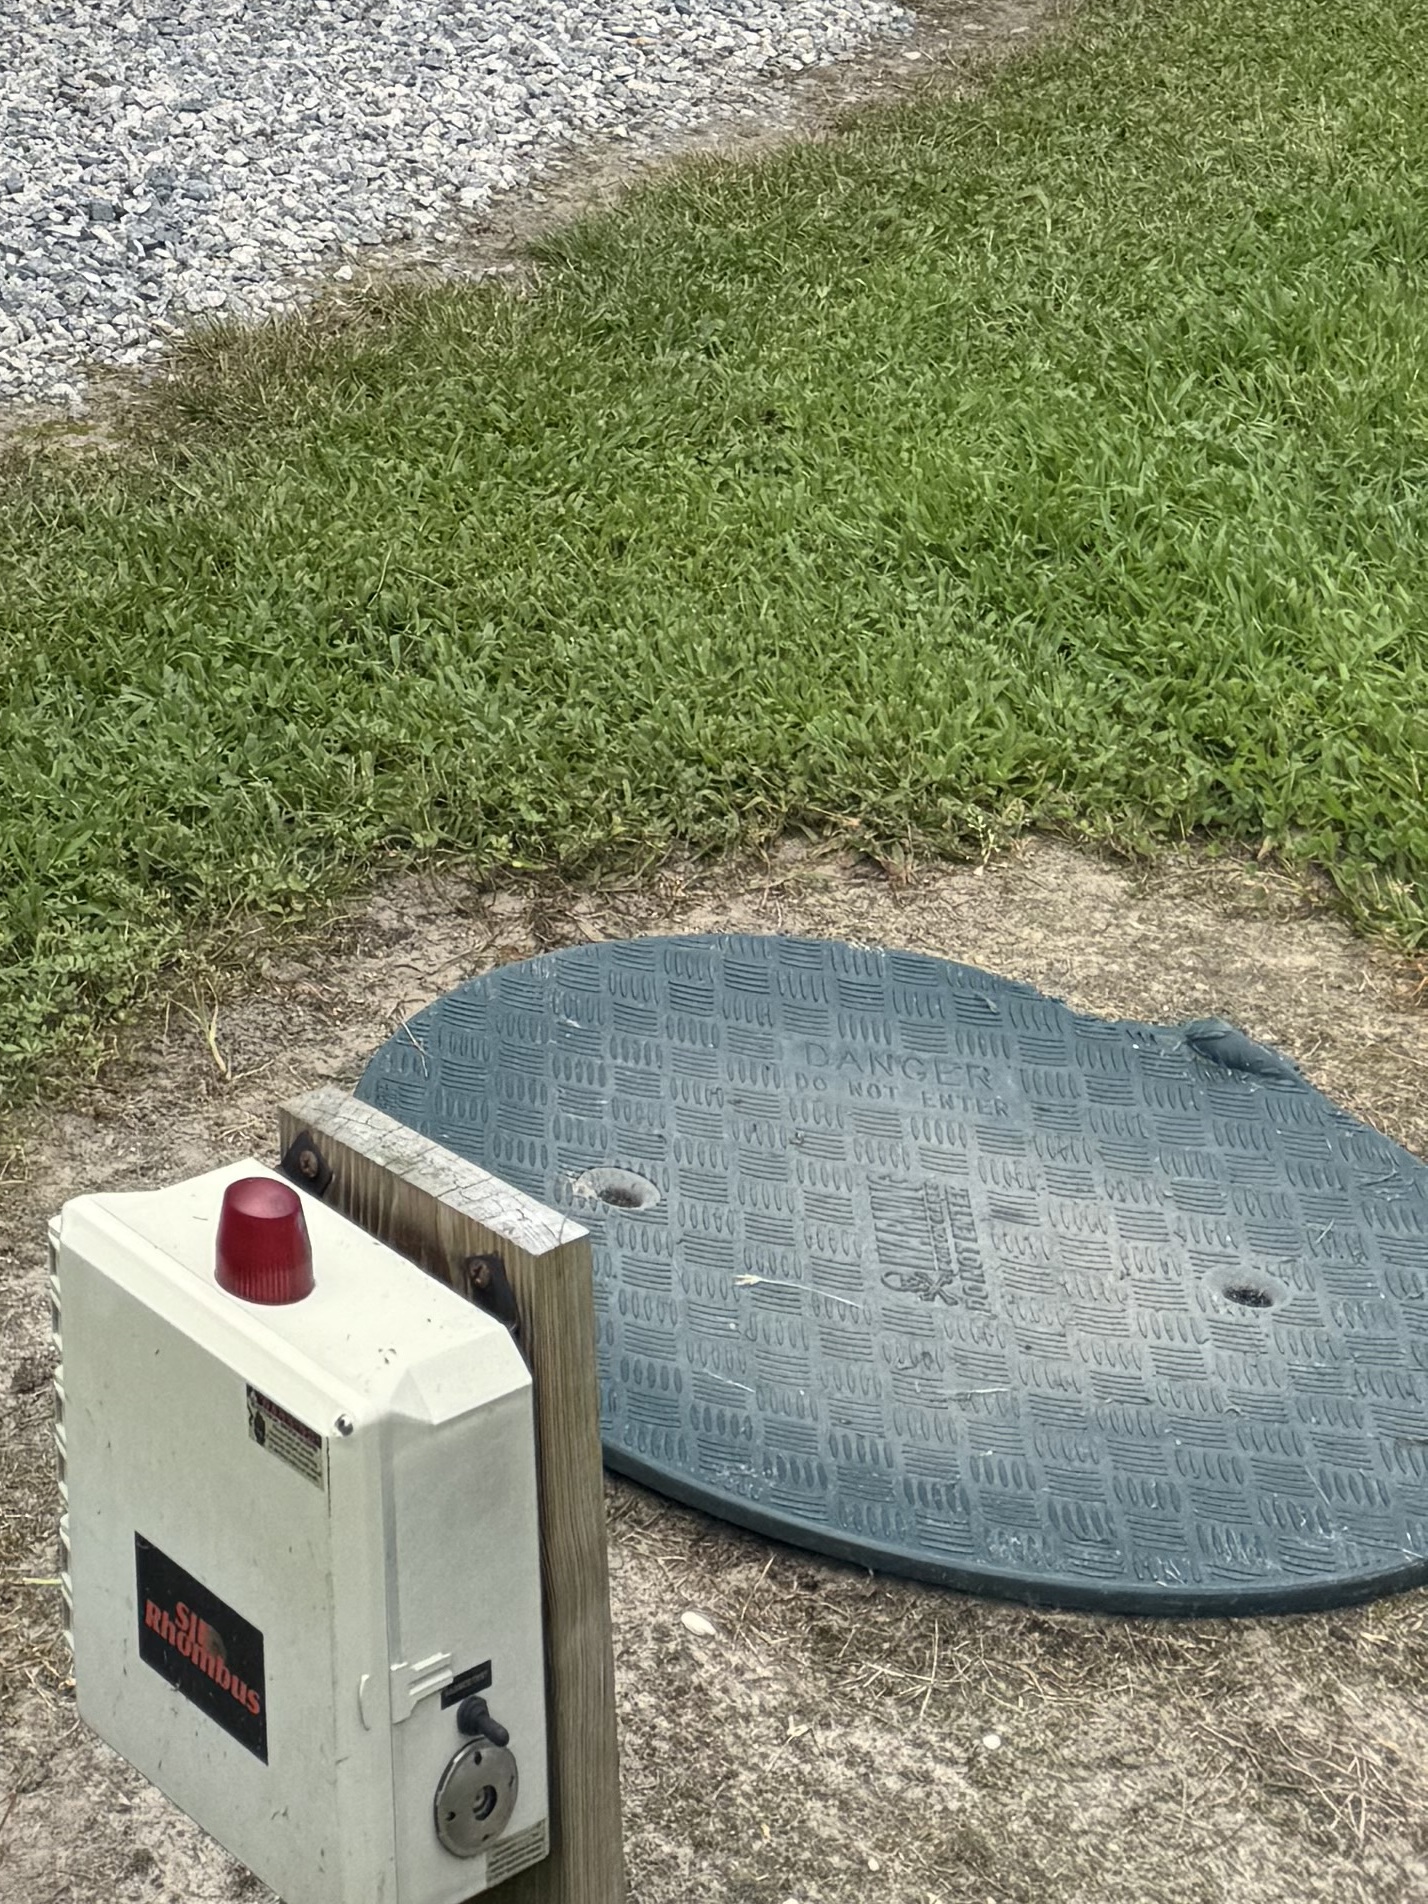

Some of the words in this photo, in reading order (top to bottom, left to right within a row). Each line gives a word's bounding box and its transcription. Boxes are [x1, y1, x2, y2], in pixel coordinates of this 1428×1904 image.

[805, 1041, 993, 1091] DANGER
[795, 1072, 828, 1091] DO
[848, 1079, 897, 1099] NOT
[921, 1091, 1009, 1118] ENTER
[144, 1598, 261, 1715] Rhombus
